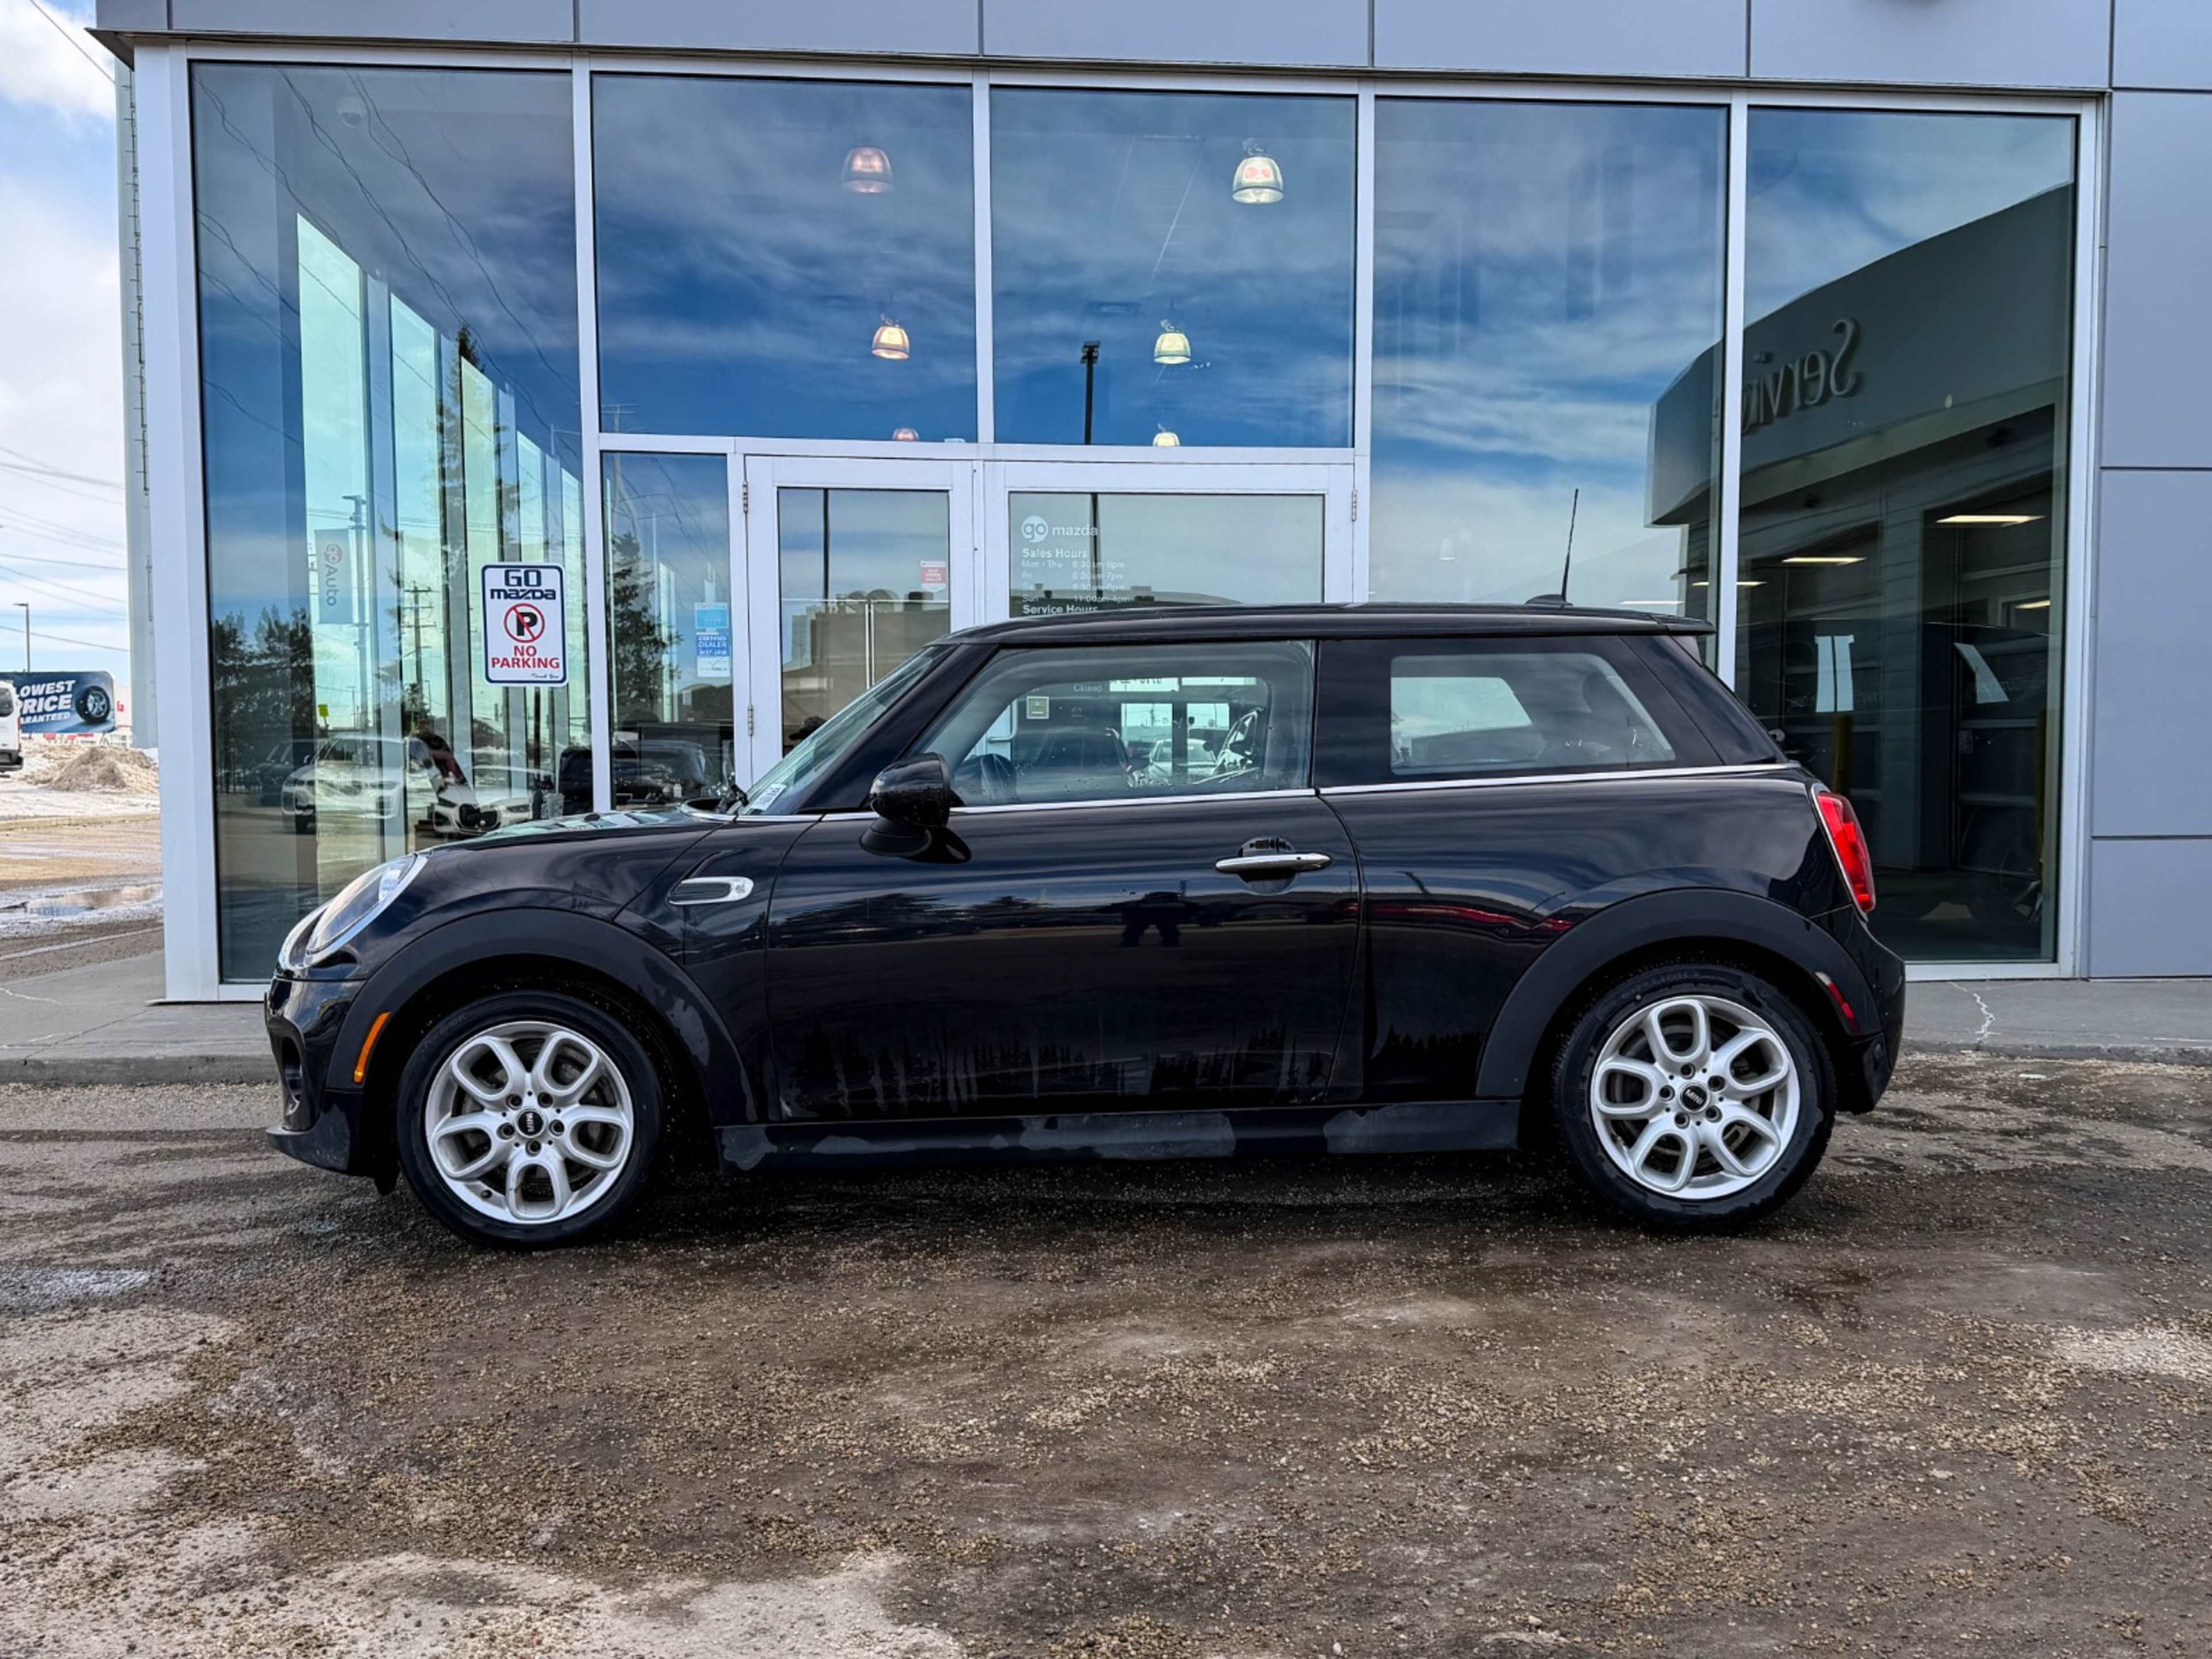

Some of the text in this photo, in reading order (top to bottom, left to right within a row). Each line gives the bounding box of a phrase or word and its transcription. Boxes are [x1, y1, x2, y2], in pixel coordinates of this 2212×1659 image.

[1052, 524, 1099, 536] mazda
[1022, 548, 1088, 558] Sales Hours
[505, 569, 542, 587] GO
[325, 564, 339, 606] Auto
[490, 589, 556, 600] mazda
[1022, 604, 1063, 615] Service
[514, 645, 537, 657] NO
[491, 657, 560, 669] PARKING
[1074, 683, 1103, 692] Closed
[1684, 1088, 1704, 1105] MINI
[526, 1112, 535, 1132] MINI
